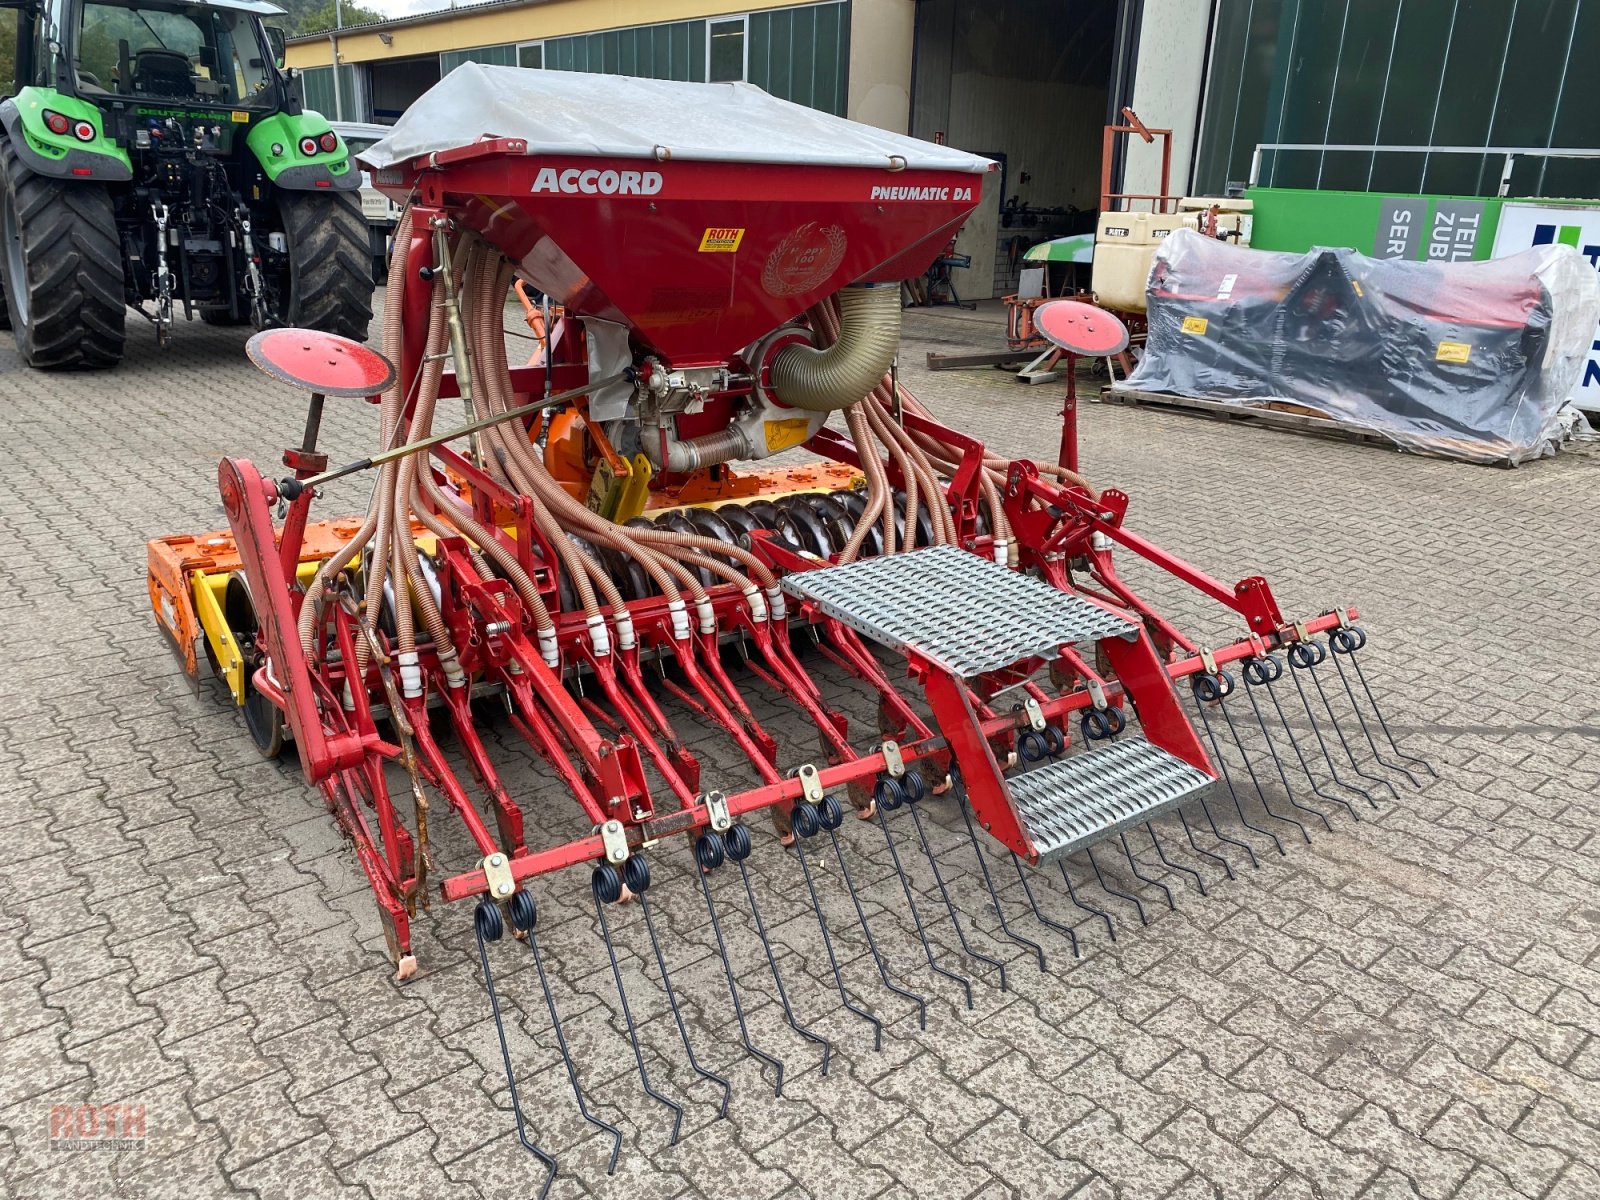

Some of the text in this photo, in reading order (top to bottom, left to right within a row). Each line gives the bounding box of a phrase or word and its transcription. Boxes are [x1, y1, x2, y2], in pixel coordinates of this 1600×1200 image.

[137, 108, 226, 120] DEUTZ-FAHR
[530, 167, 663, 195] ACCORD
[870, 186, 972, 201] PNEUMATIC DA
[708, 229, 739, 240] ROTH
[1427, 211, 1455, 263] ZUB
[1451, 213, 1480, 264] TEIL
[790, 247, 826, 256] HPPY
